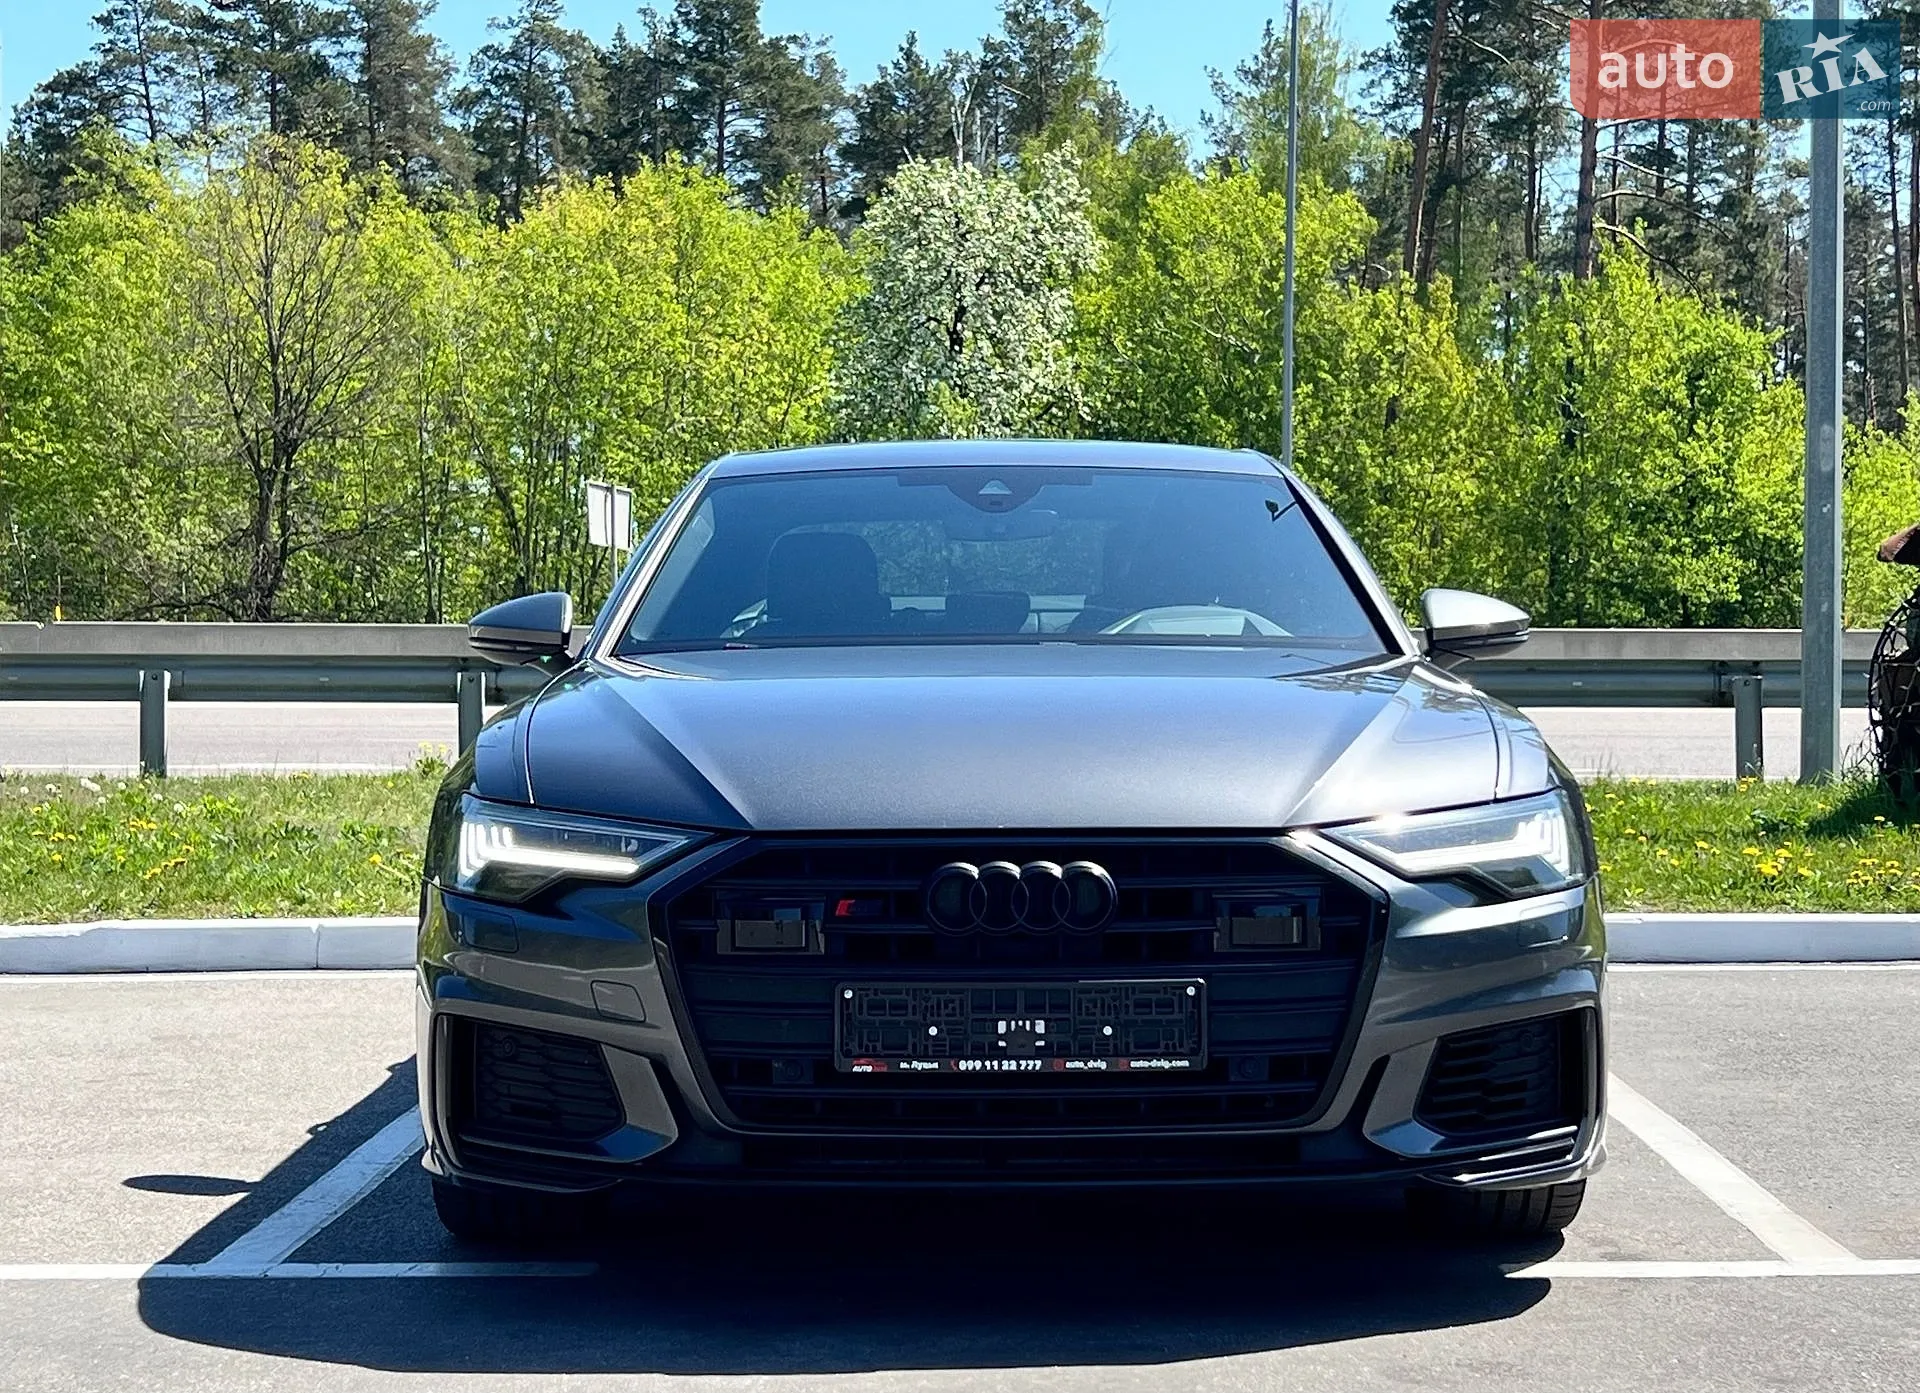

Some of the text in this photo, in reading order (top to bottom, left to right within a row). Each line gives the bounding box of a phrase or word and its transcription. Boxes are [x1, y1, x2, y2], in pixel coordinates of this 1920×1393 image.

[958, 1059, 1042, 1071] 099 11 22 777
